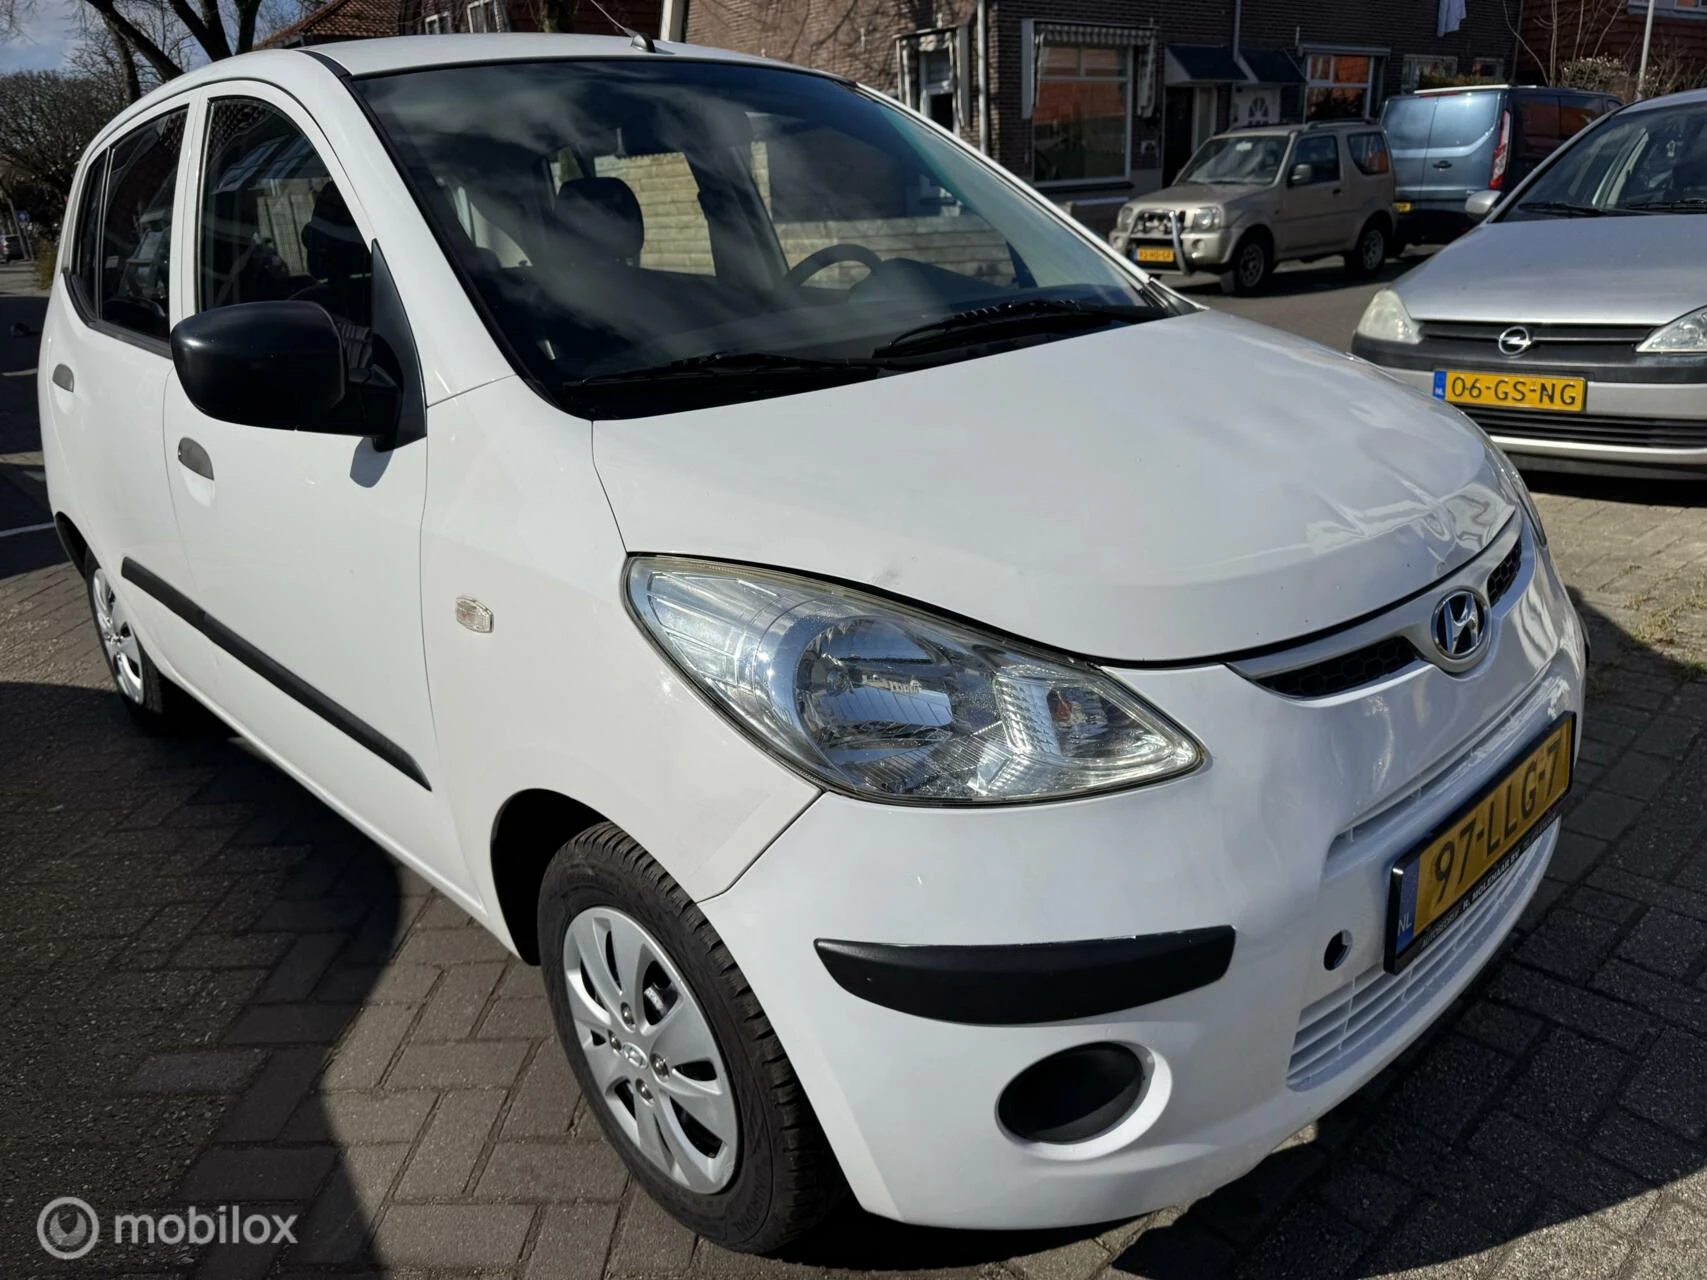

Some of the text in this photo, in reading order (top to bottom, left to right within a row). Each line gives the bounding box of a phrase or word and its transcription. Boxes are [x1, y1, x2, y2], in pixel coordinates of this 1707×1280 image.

[1452, 376, 1576, 405] 06-GS-NG
[1434, 739, 1562, 904] 97-LLG-7
[1398, 913, 1412, 935] NL
